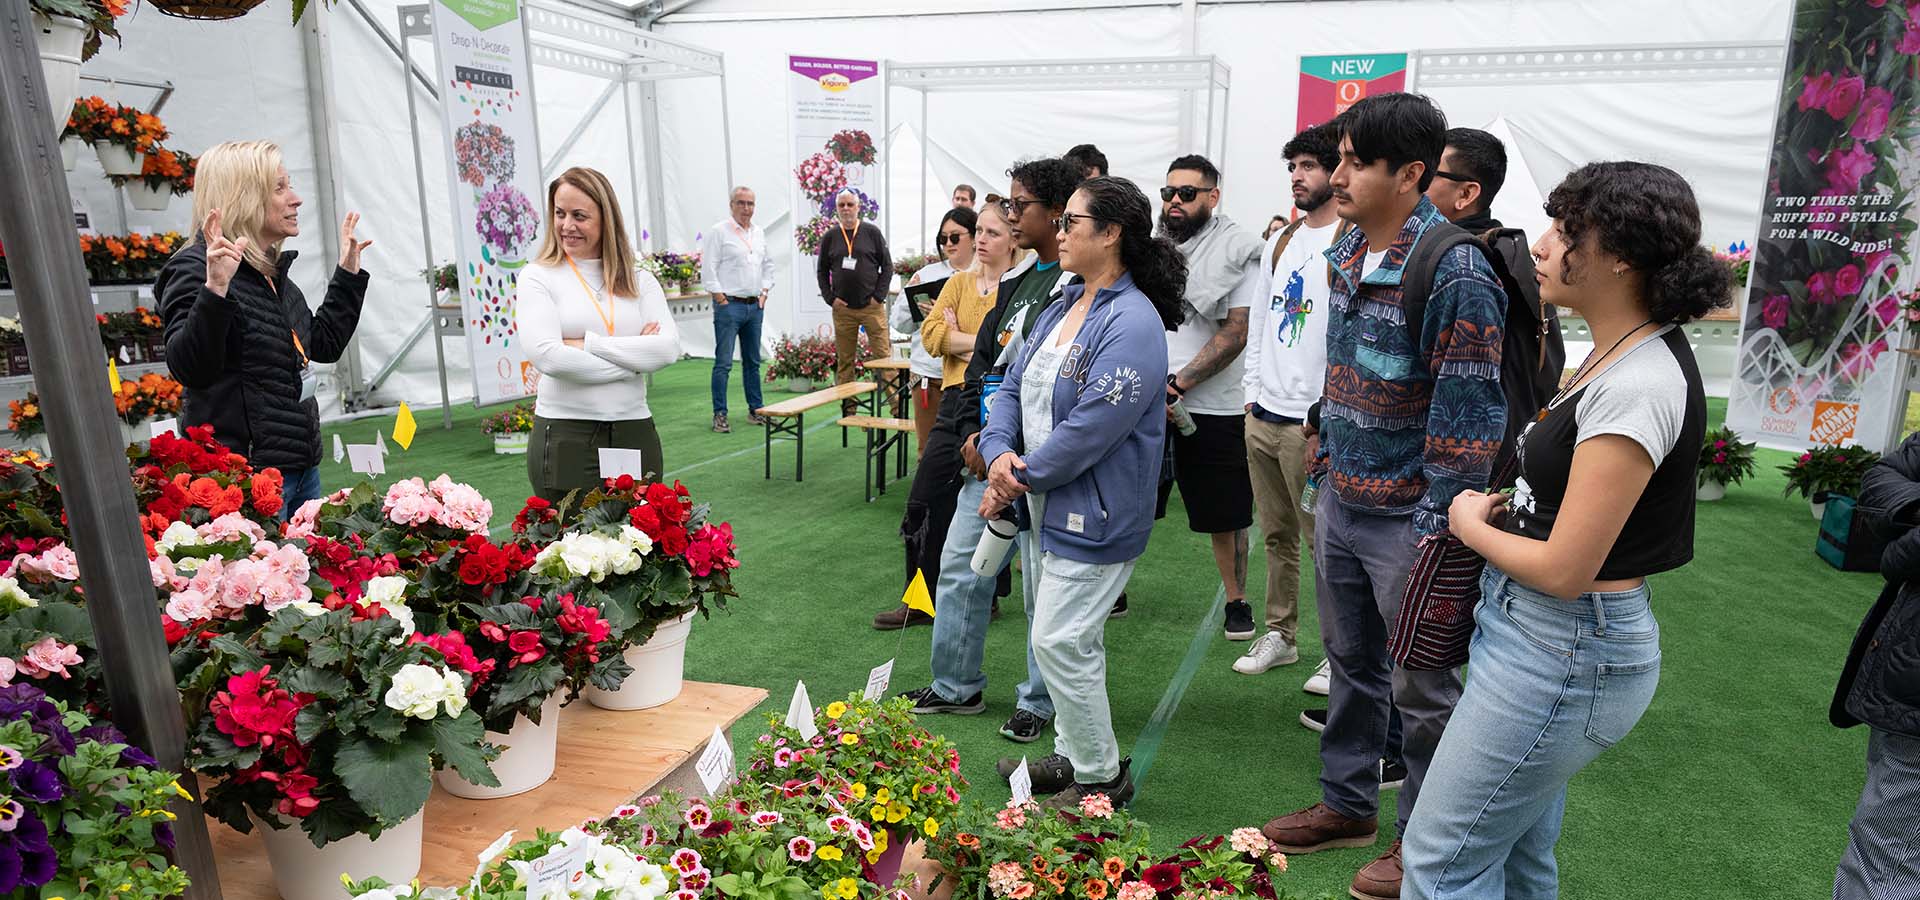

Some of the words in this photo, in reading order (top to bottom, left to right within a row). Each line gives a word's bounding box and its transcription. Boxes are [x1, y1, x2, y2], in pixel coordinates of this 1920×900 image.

[1331, 59, 1375, 75] NEW
[457, 71, 512, 86] confetti
[822, 79, 848, 88] Vigoro
[1775, 197, 1806, 207] TWO
[1810, 195, 1858, 207] TIMES
[1862, 194, 1893, 206] THE
[1771, 212, 1836, 223] RUFFLED
[1839, 211, 1899, 223] PETALS
[1768, 228, 1797, 239] FOR
[1799, 228, 1808, 239] A
[1811, 229, 1850, 247] WILD
[1849, 238, 1893, 254] RIDE!
[1094, 372, 1113, 393] LOS
[1115, 366, 1142, 404] ANGELES
[1811, 403, 1857, 441] HOME
[1817, 406, 1837, 422] THE
